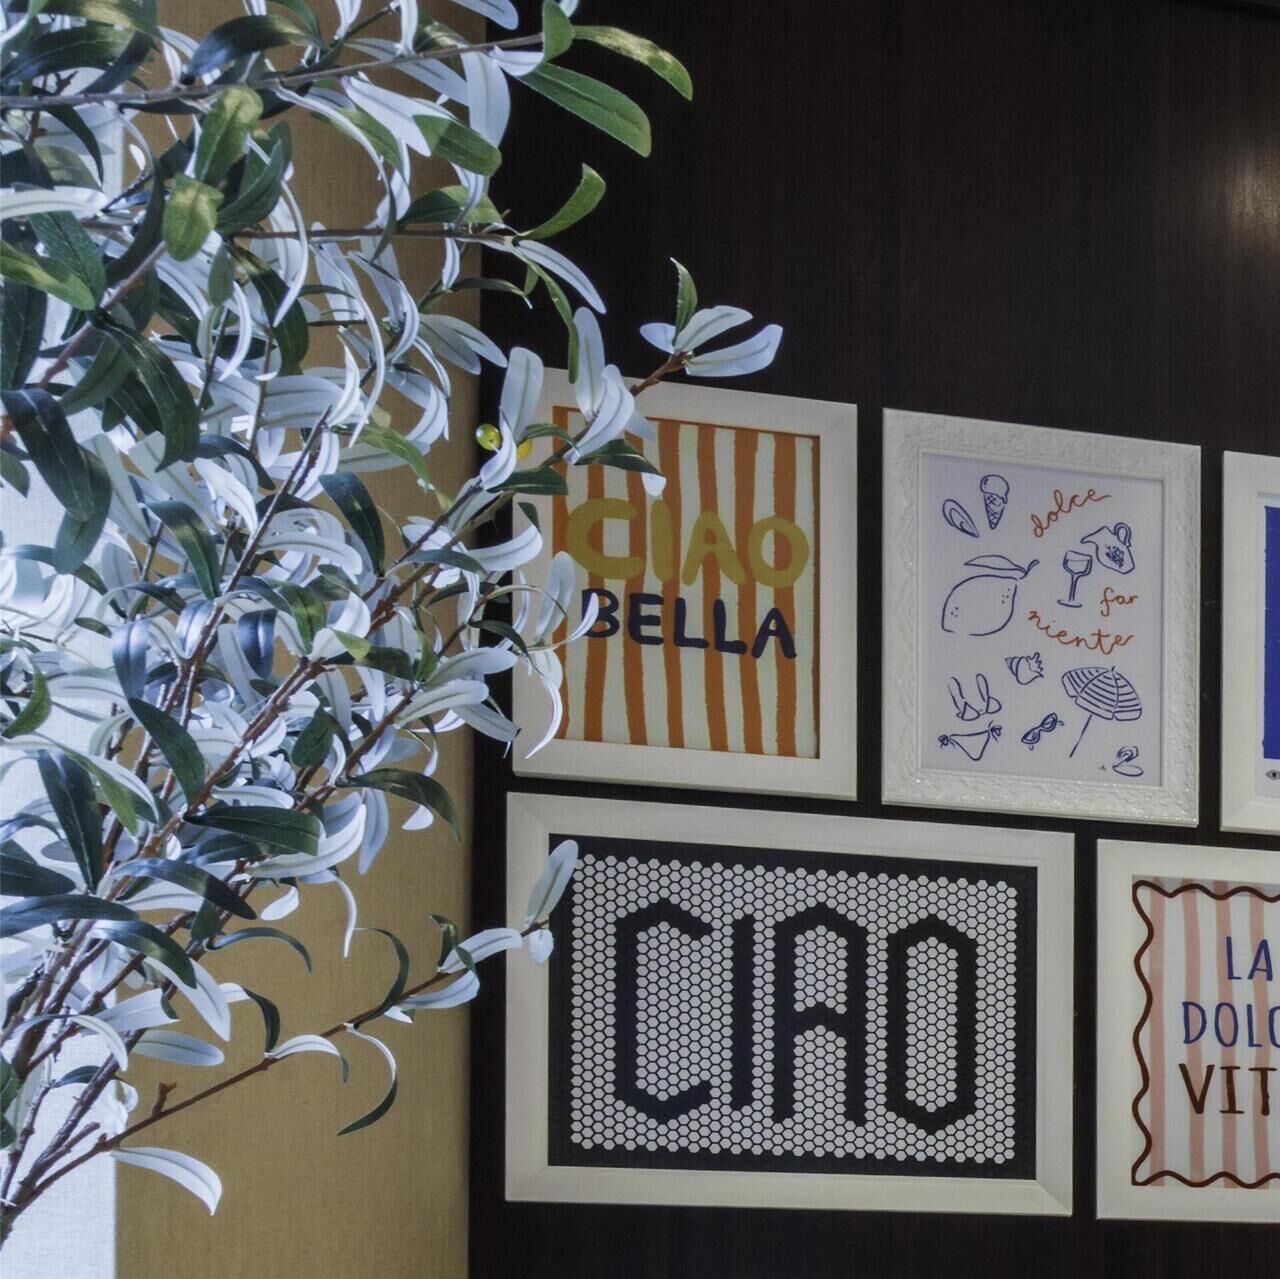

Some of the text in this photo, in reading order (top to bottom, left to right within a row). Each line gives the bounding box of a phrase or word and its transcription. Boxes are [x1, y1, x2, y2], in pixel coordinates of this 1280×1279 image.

[1031, 488, 1112, 538] dolce
[566, 497, 810, 589] CIAO
[580, 588, 798, 660] BELLA
[1100, 587, 1139, 617] far
[1028, 609, 1135, 655] niente
[1226, 936, 1273, 982] LA
[615, 899, 977, 1135] CIAO
